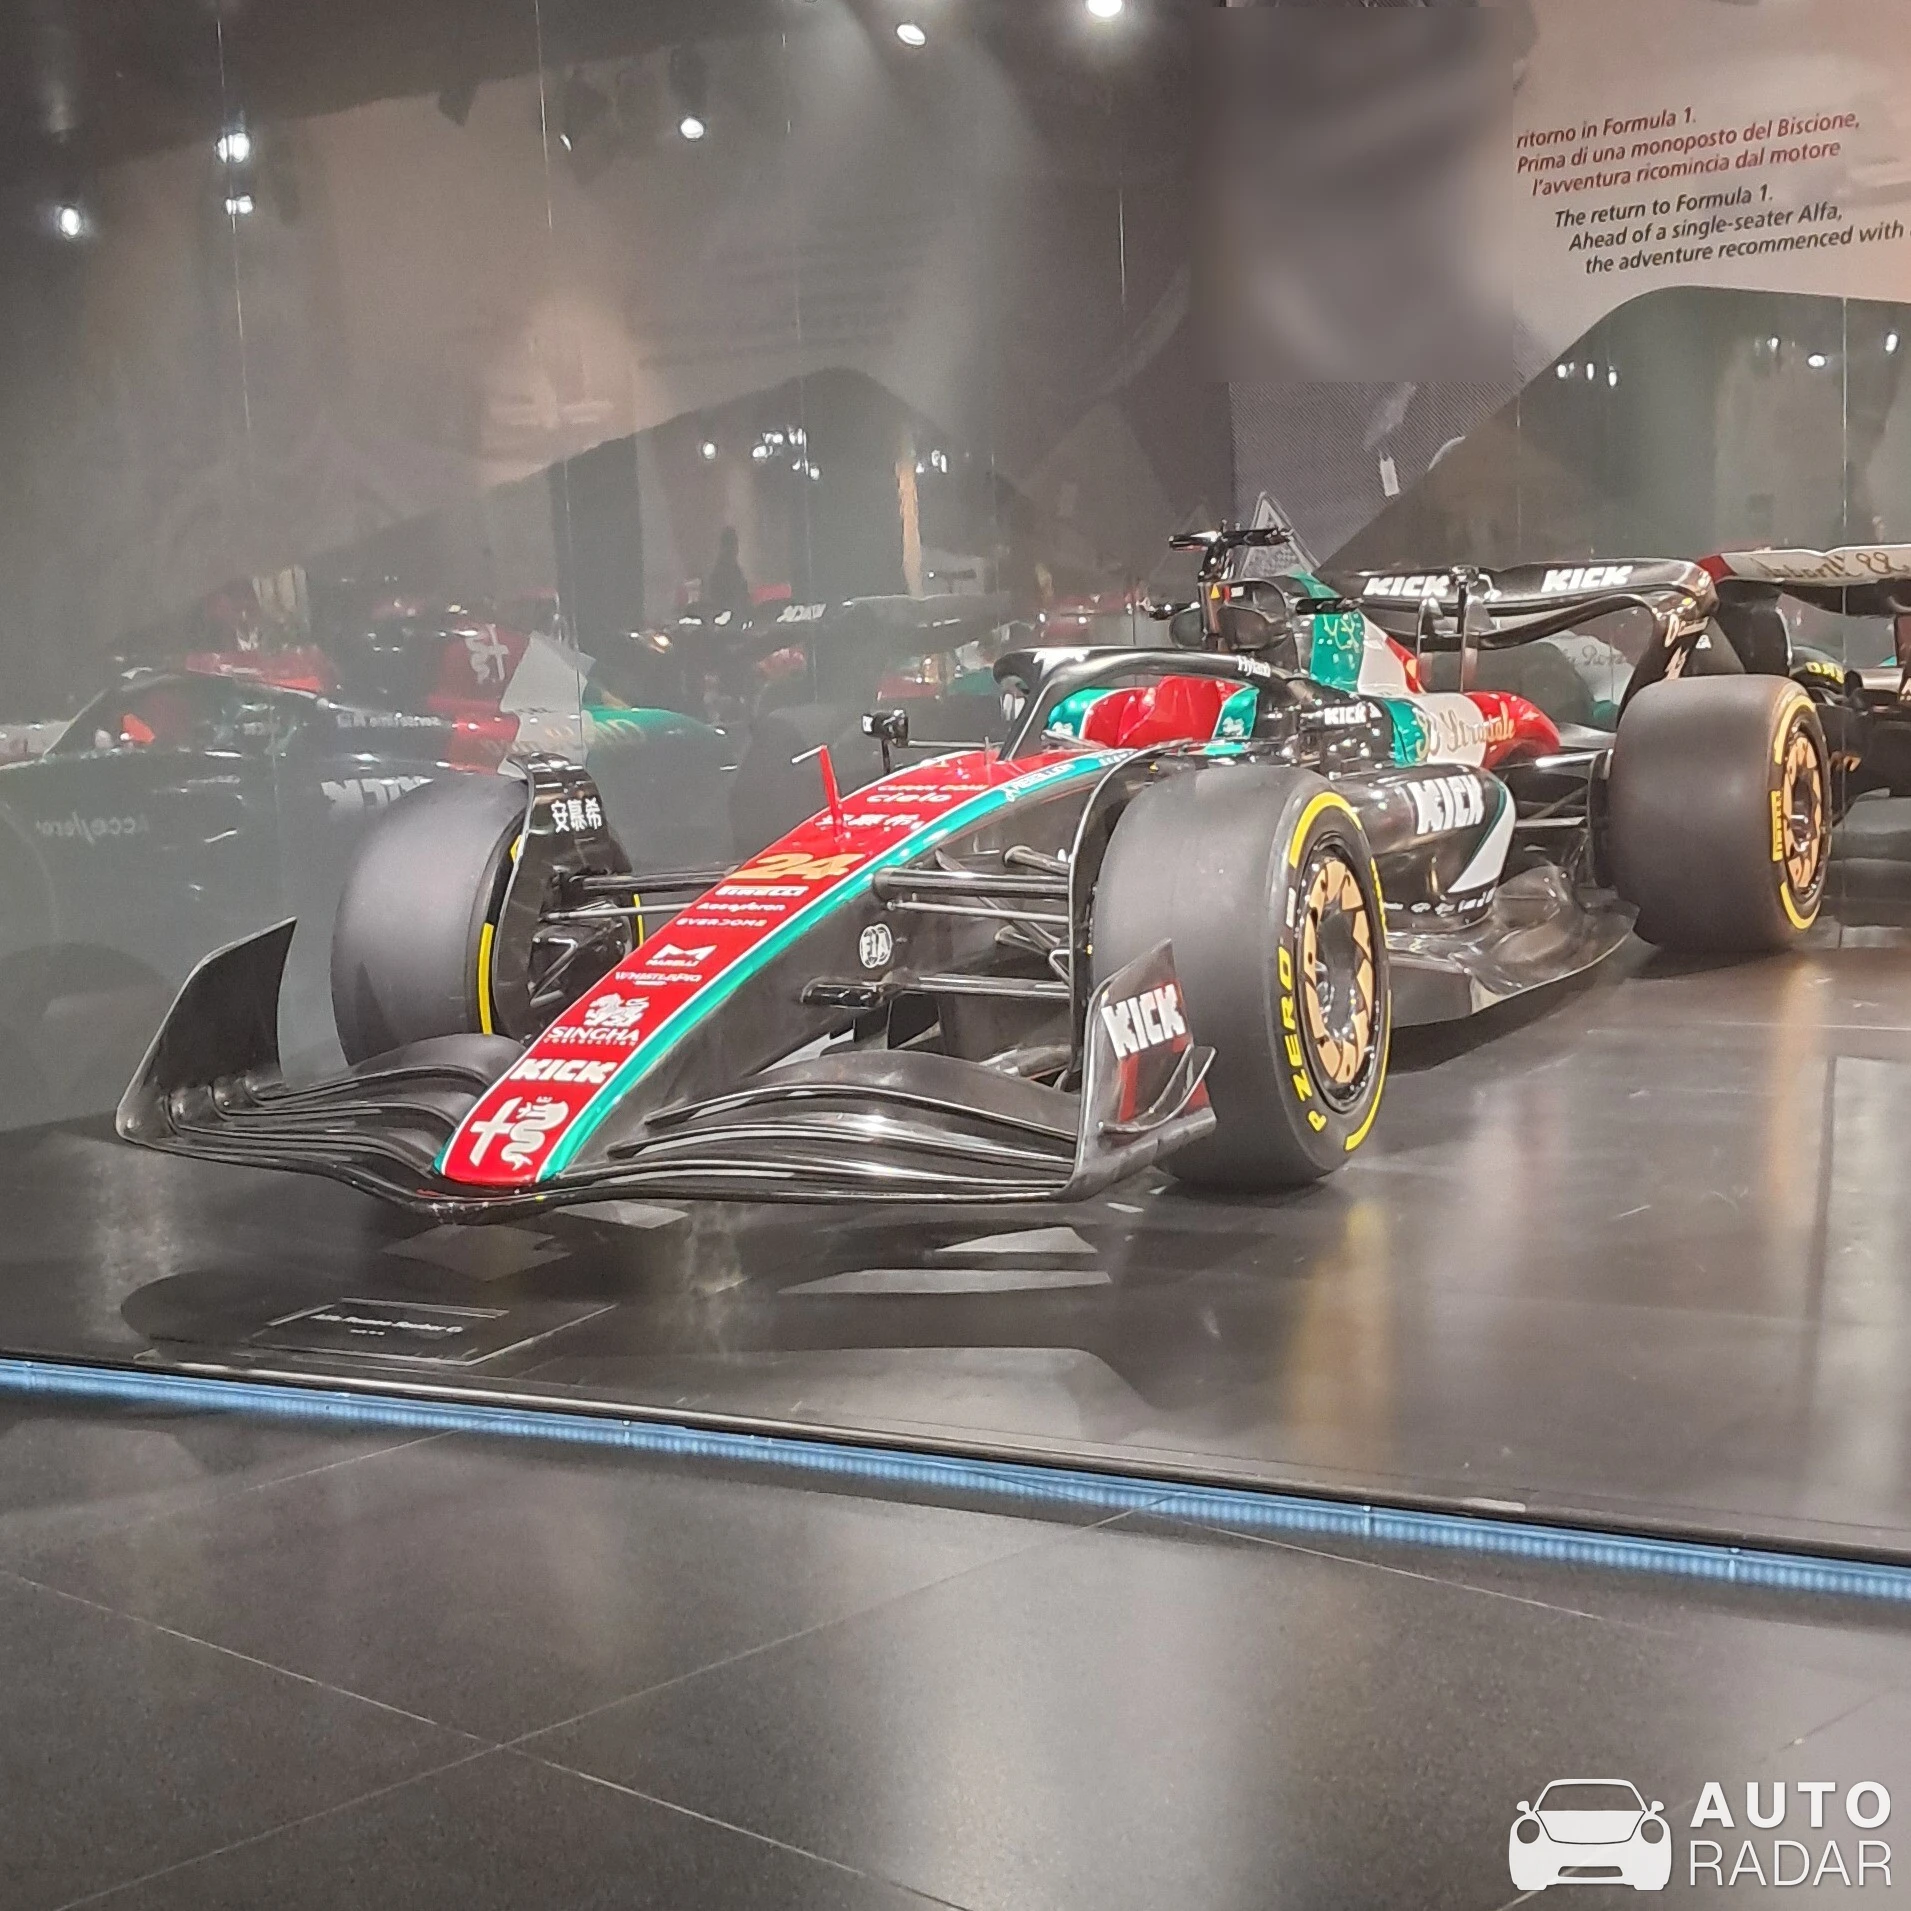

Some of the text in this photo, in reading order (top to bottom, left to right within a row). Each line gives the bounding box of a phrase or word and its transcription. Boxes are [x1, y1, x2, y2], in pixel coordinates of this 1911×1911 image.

[1516, 106, 1696, 148] ritorno in Formula 1.
[1517, 112, 1860, 174] Prima di una monoposto del Biscione,
[1636, 154, 1730, 182] ricomincia
[1735, 147, 1765, 169] dal
[1769, 142, 1841, 164] motore
[1555, 184, 1773, 228] The return to Formula 1.
[1568, 201, 1843, 251] Ahead of a single-seater Alfa,
[1585, 220, 1904, 275] the adventure recommenced with
[1362, 575, 1450, 597] KICK
[1540, 565, 1634, 594] KICK
[1324, 703, 1366, 725] KICK
[1406, 774, 1484, 835] KICK
[727, 853, 867, 880] 24
[548, 1026, 640, 1042] SINGHA
[1101, 984, 1186, 1058] KICK
[1278, 946, 1327, 1132] P ZERO
[509, 1058, 618, 1085] KICK
